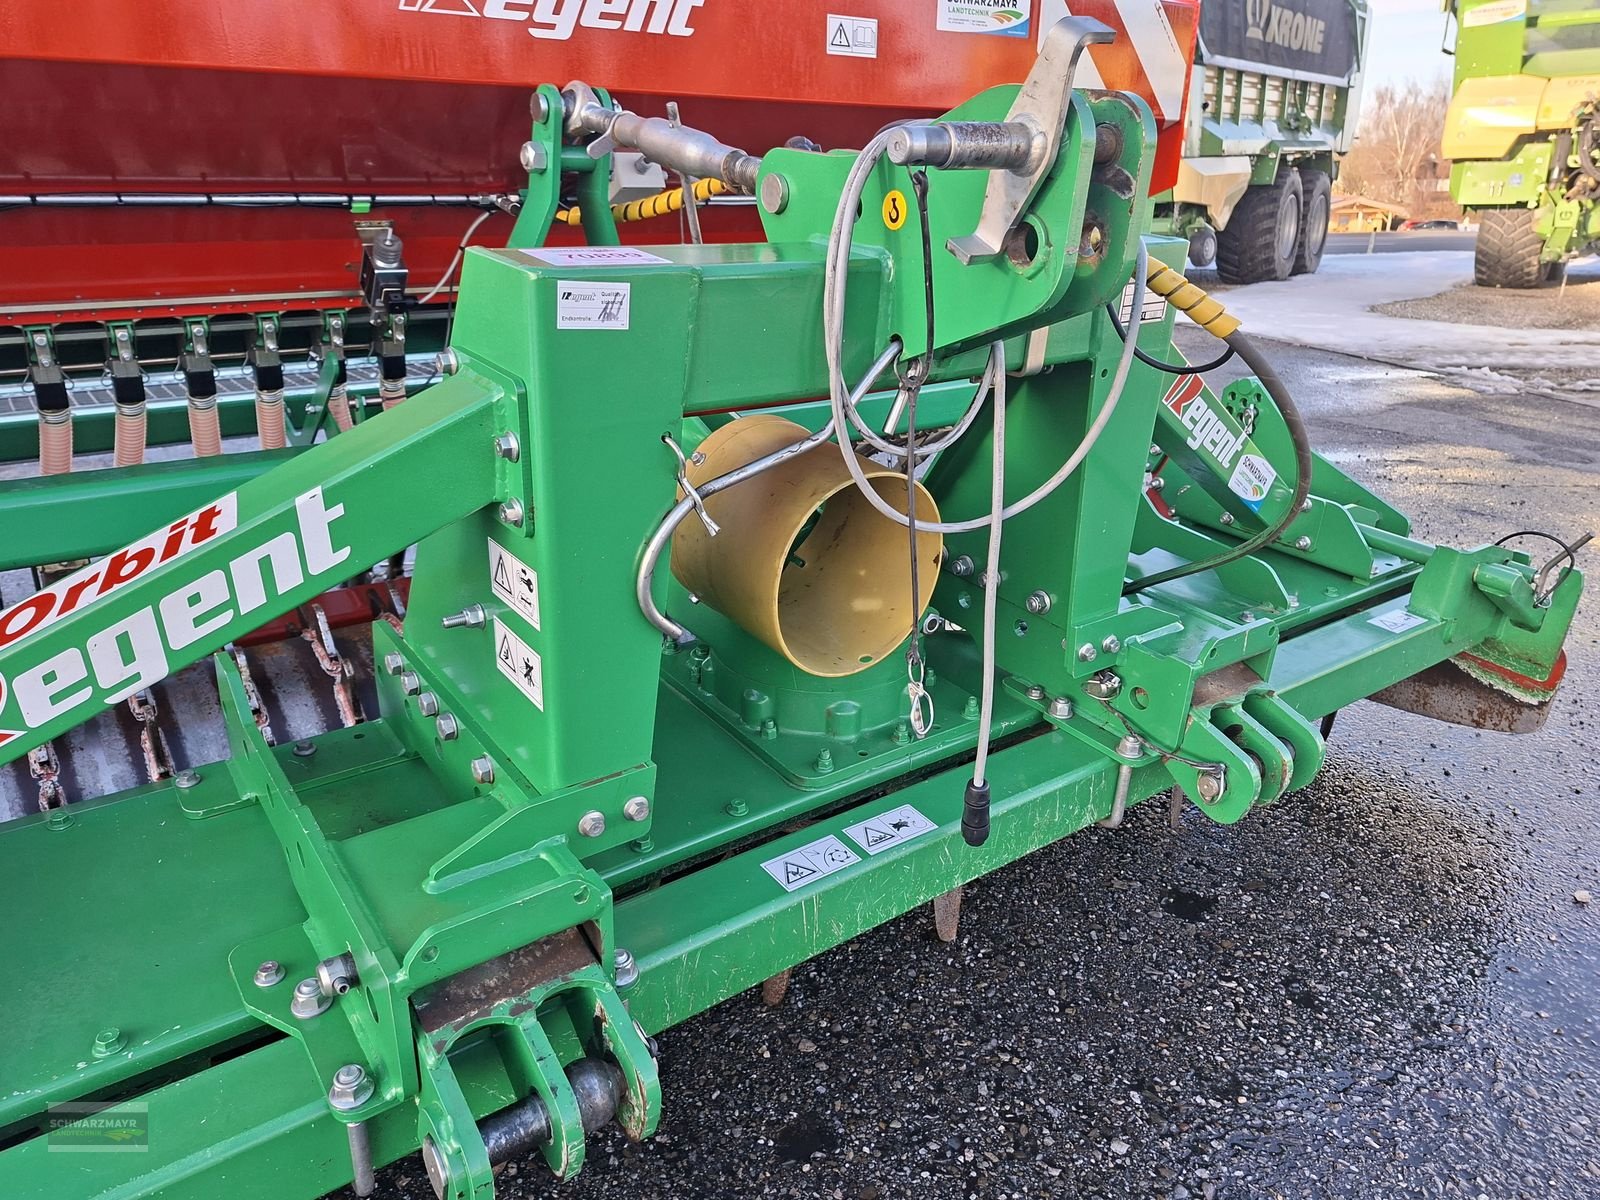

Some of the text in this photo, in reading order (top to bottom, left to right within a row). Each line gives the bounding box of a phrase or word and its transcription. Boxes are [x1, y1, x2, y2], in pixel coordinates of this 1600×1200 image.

[948, 6, 990, 16] LANDTECHNIK
[1265, 4, 1325, 54] KRONE
[1162, 364, 1246, 468] Regent
[0, 485, 351, 747] egent
